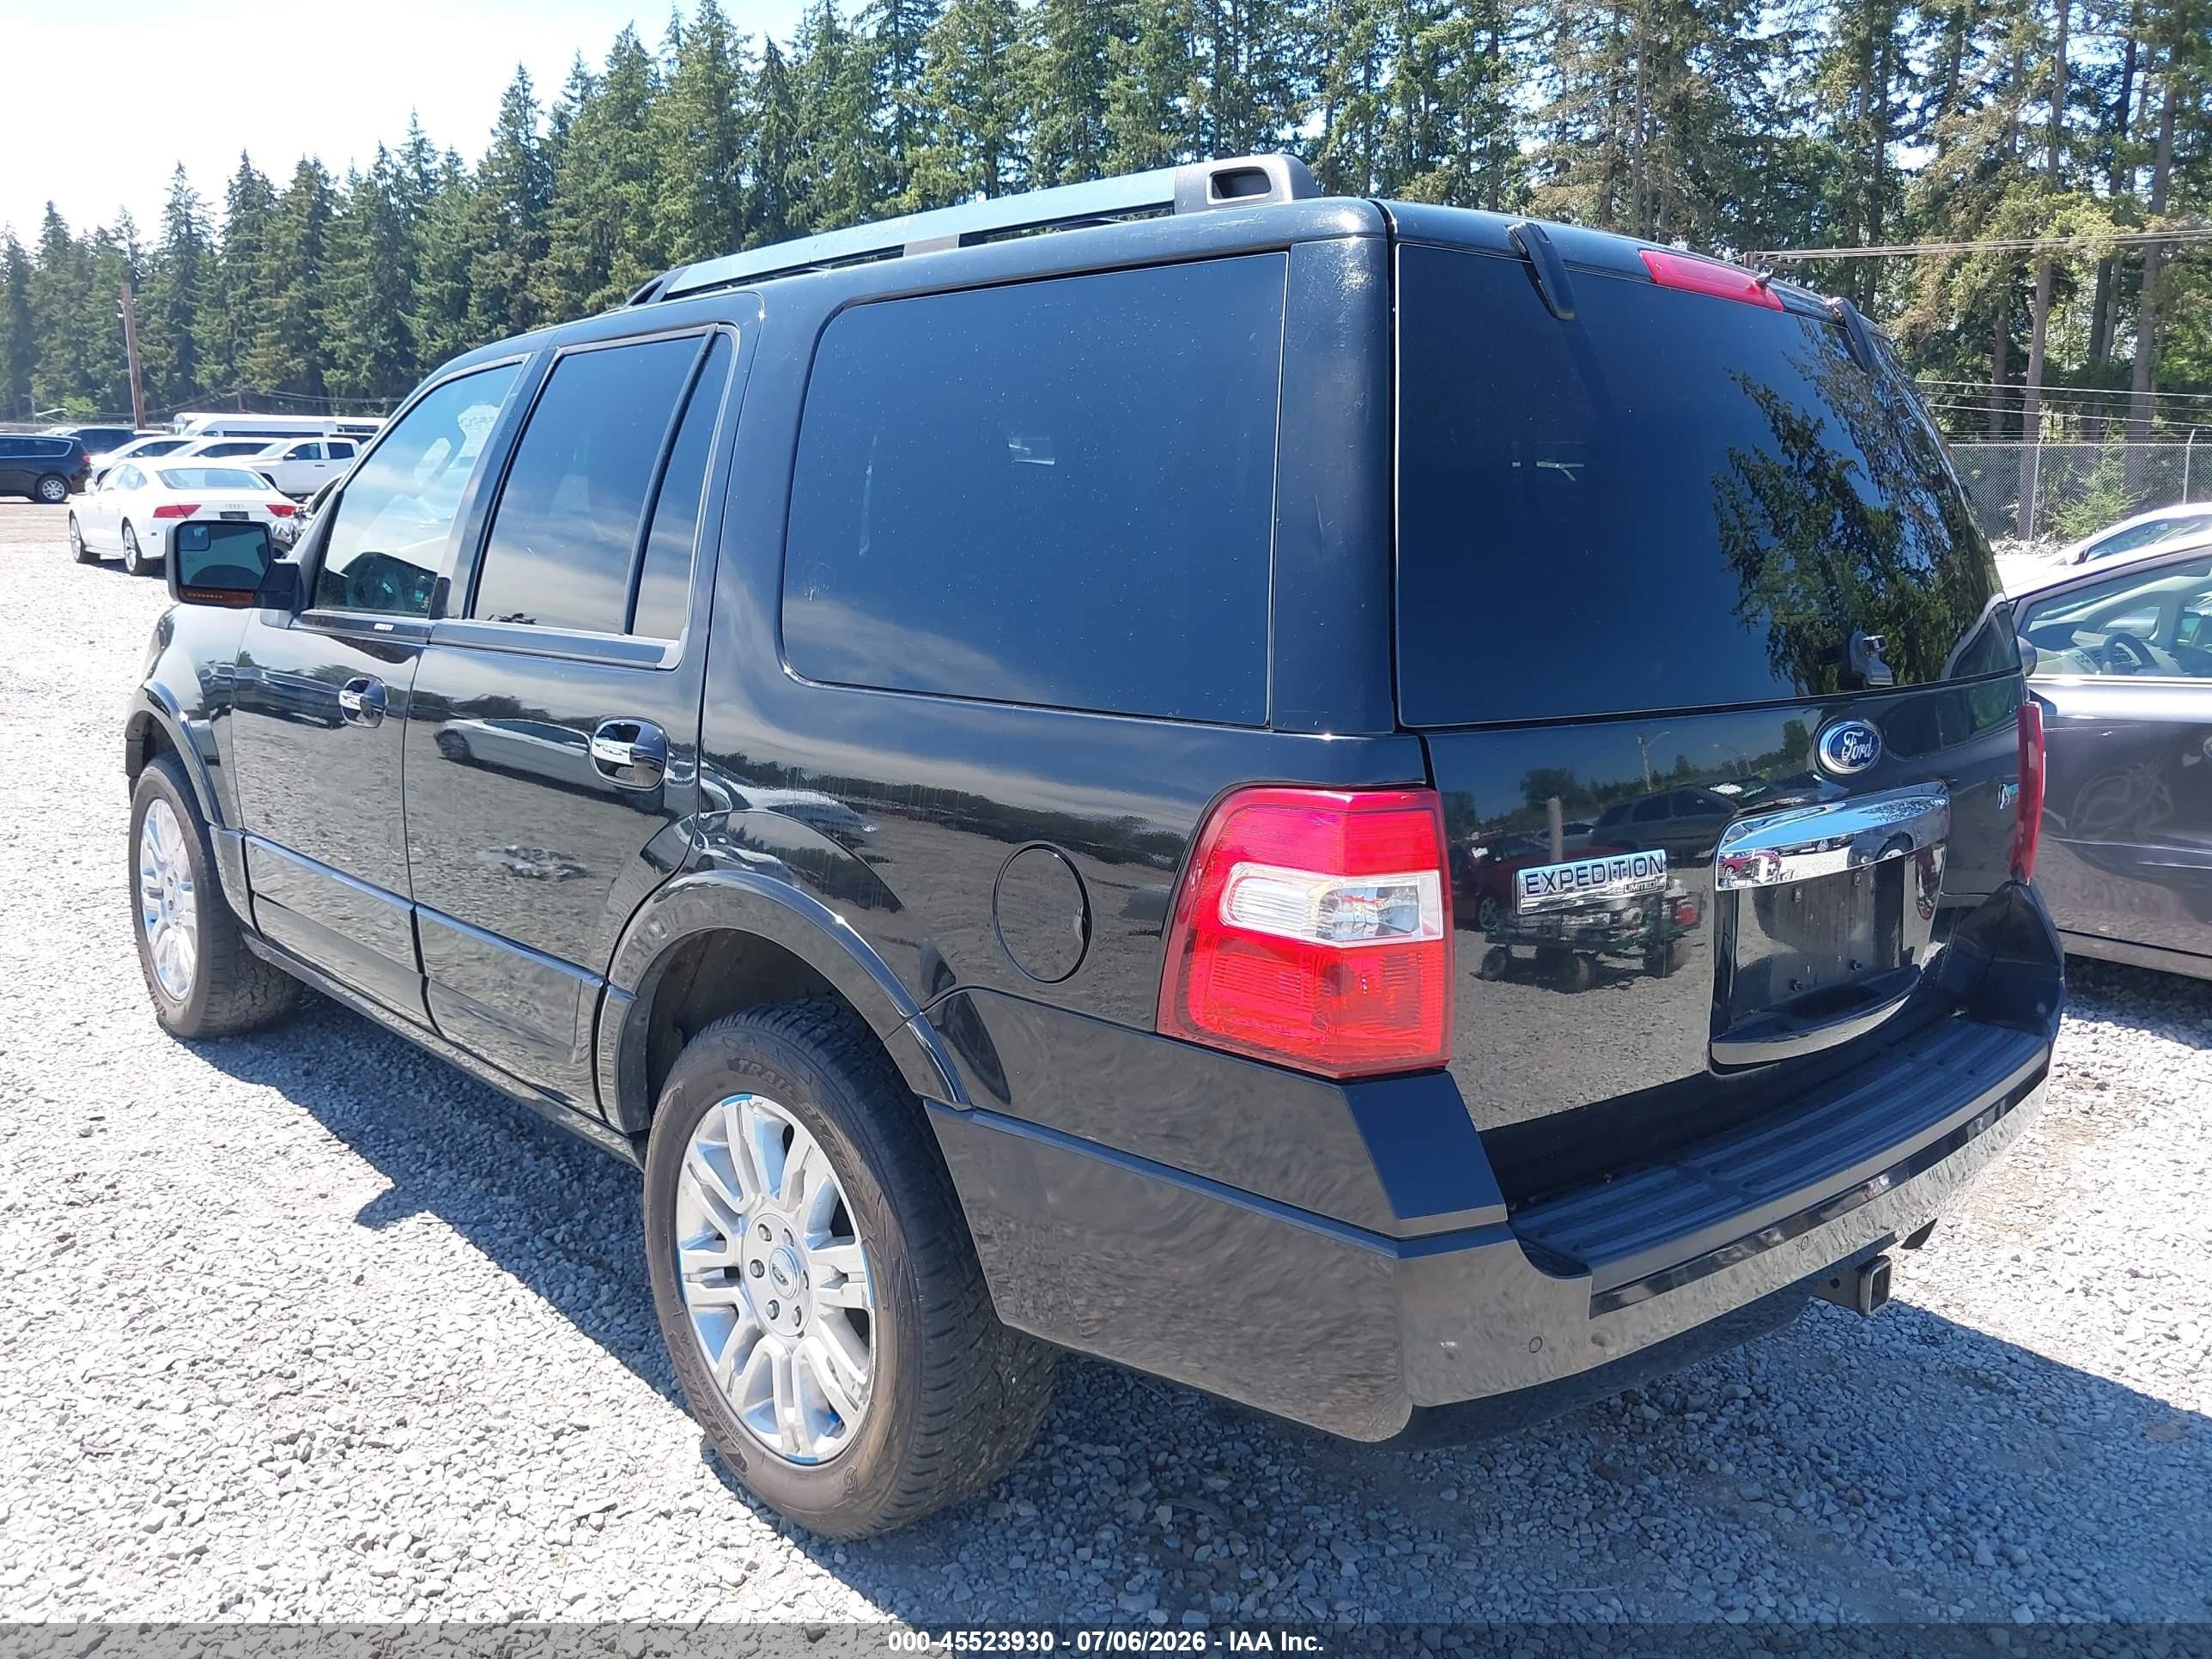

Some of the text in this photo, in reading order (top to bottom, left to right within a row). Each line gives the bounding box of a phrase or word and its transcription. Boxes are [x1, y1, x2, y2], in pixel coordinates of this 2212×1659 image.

[1841, 730, 1875, 762] Ford
[1524, 853, 1664, 896] EXPEDITION
[1623, 881, 1656, 894] LIMITED
[738, 1060, 793, 1096] TRAIL
